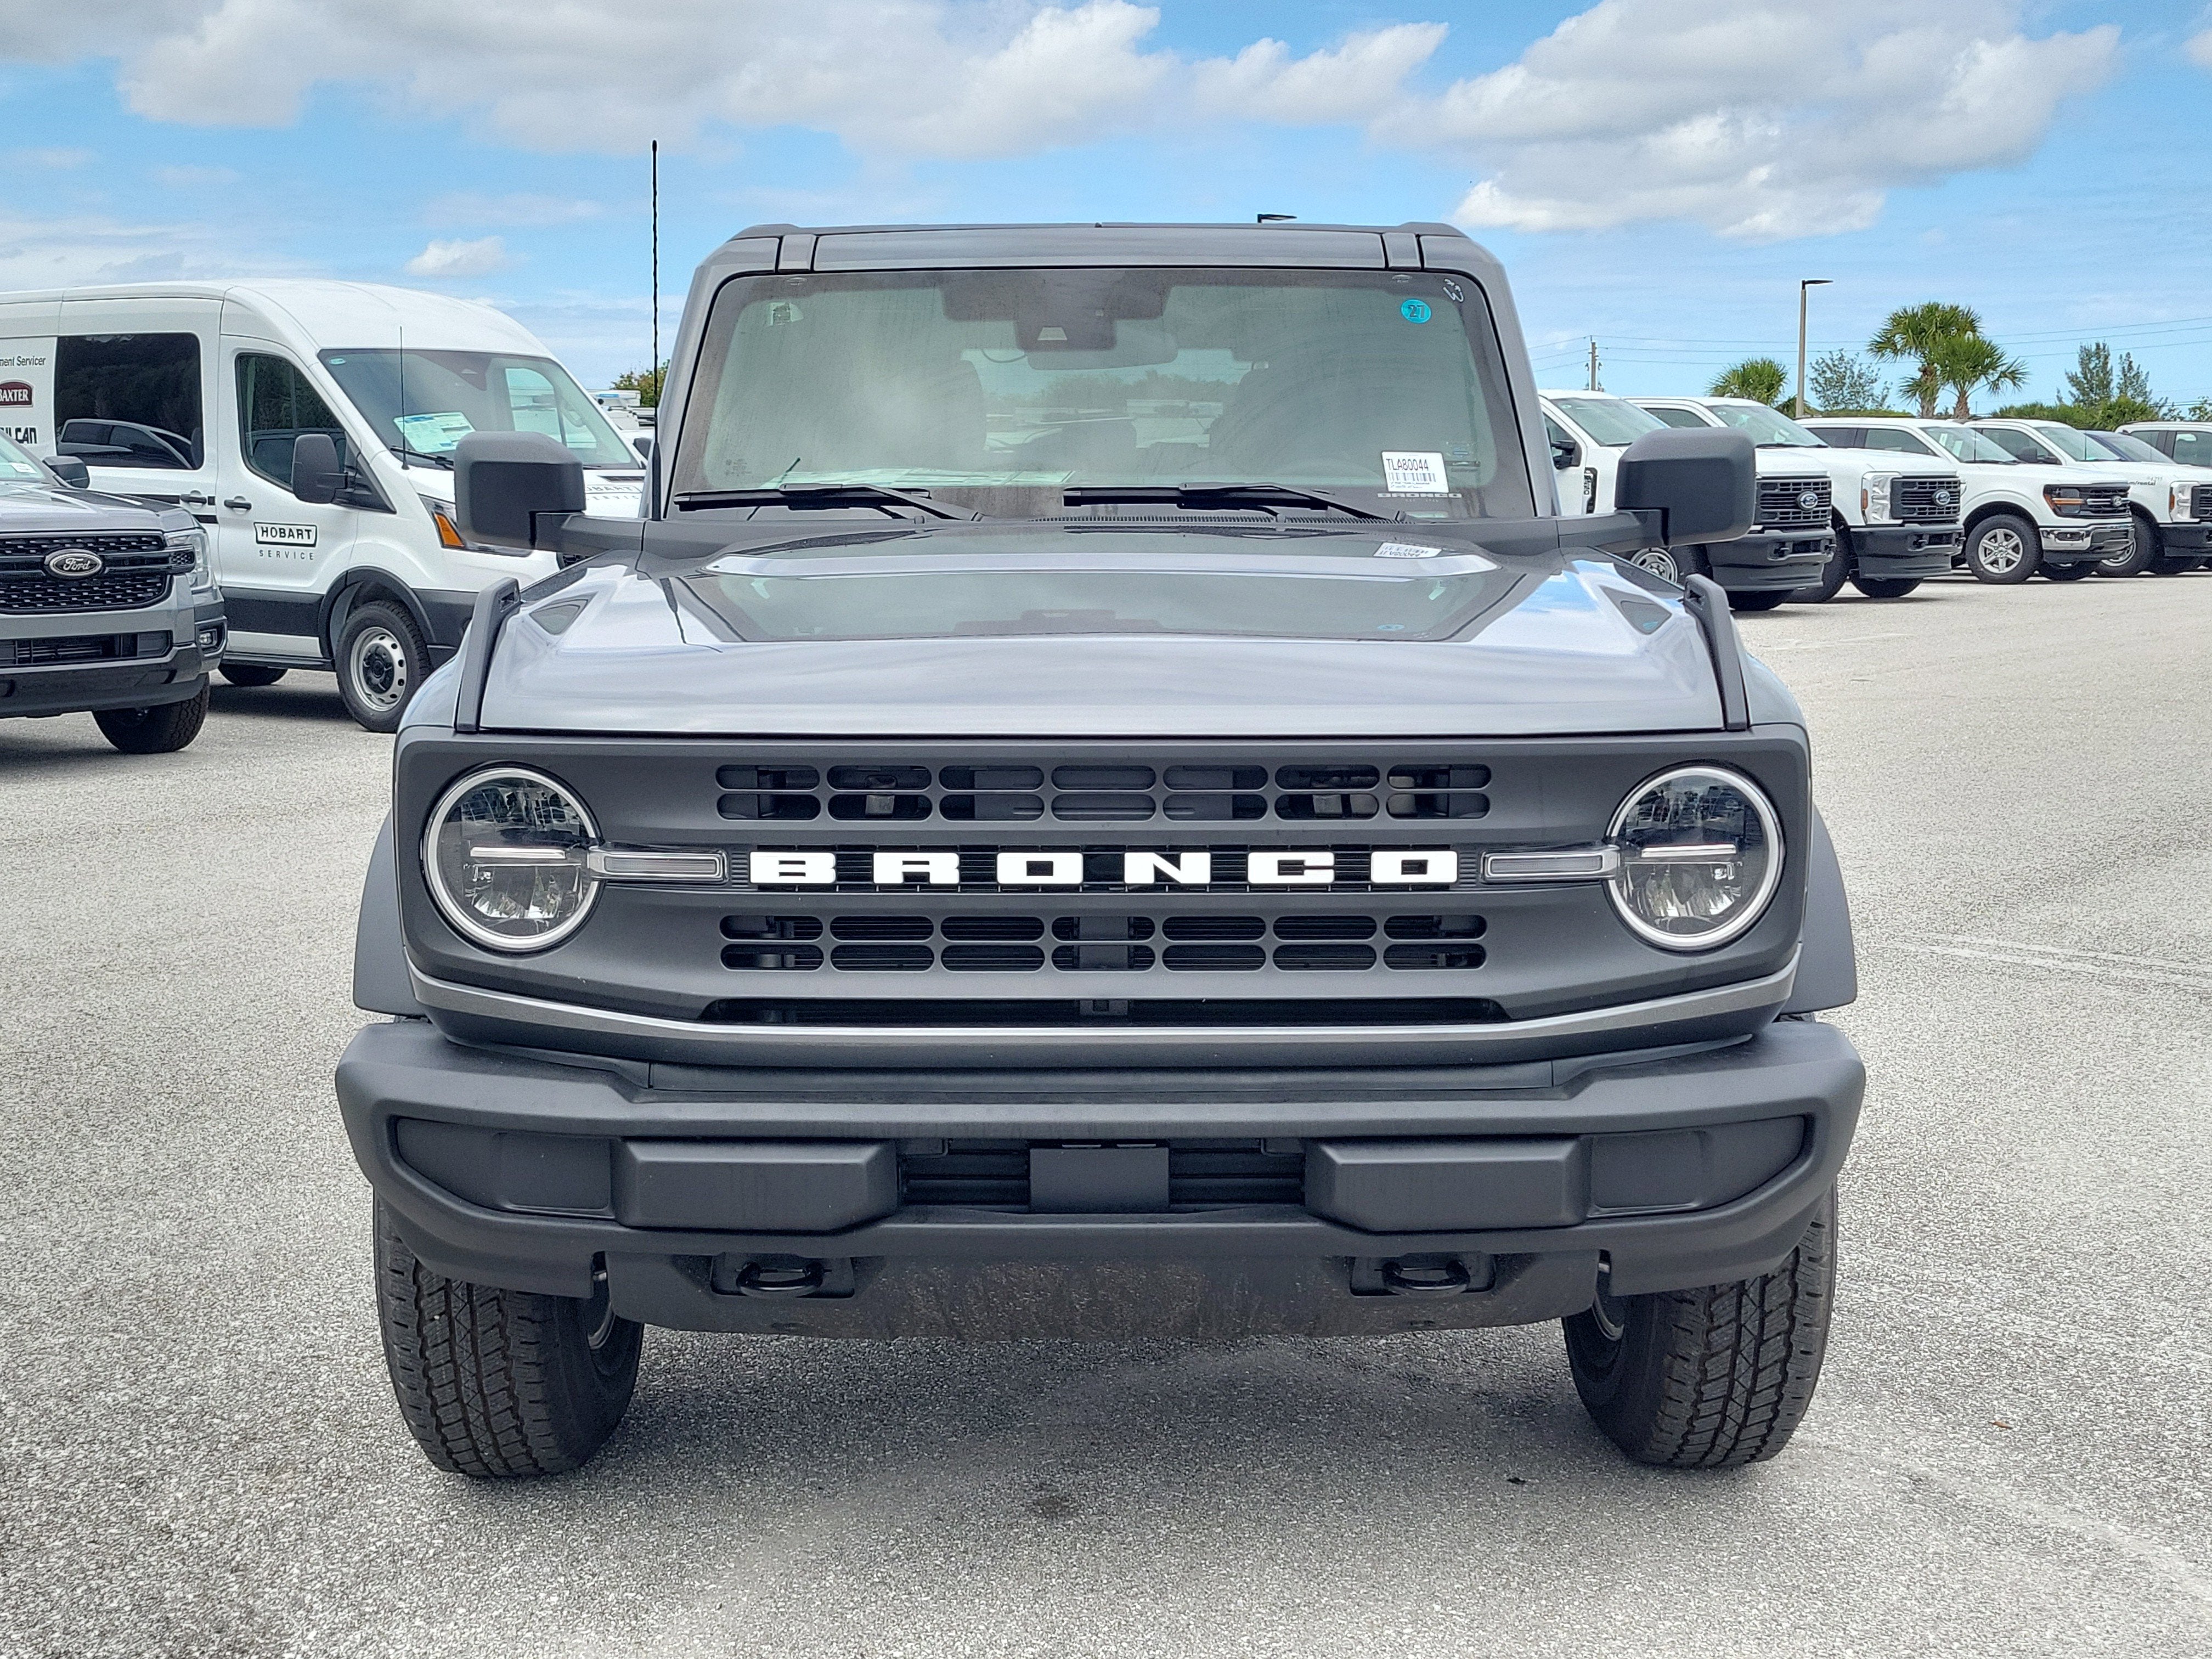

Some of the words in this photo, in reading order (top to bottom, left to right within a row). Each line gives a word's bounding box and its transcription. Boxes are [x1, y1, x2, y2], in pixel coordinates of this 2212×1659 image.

[16, 356, 46, 366] Servicer
[1386, 459, 1429, 471] TLA80044
[261, 526, 312, 539] HOBART
[259, 550, 313, 560] SERVICE
[63, 557, 91, 571] Ford
[749, 851, 1458, 884] BRONCO
